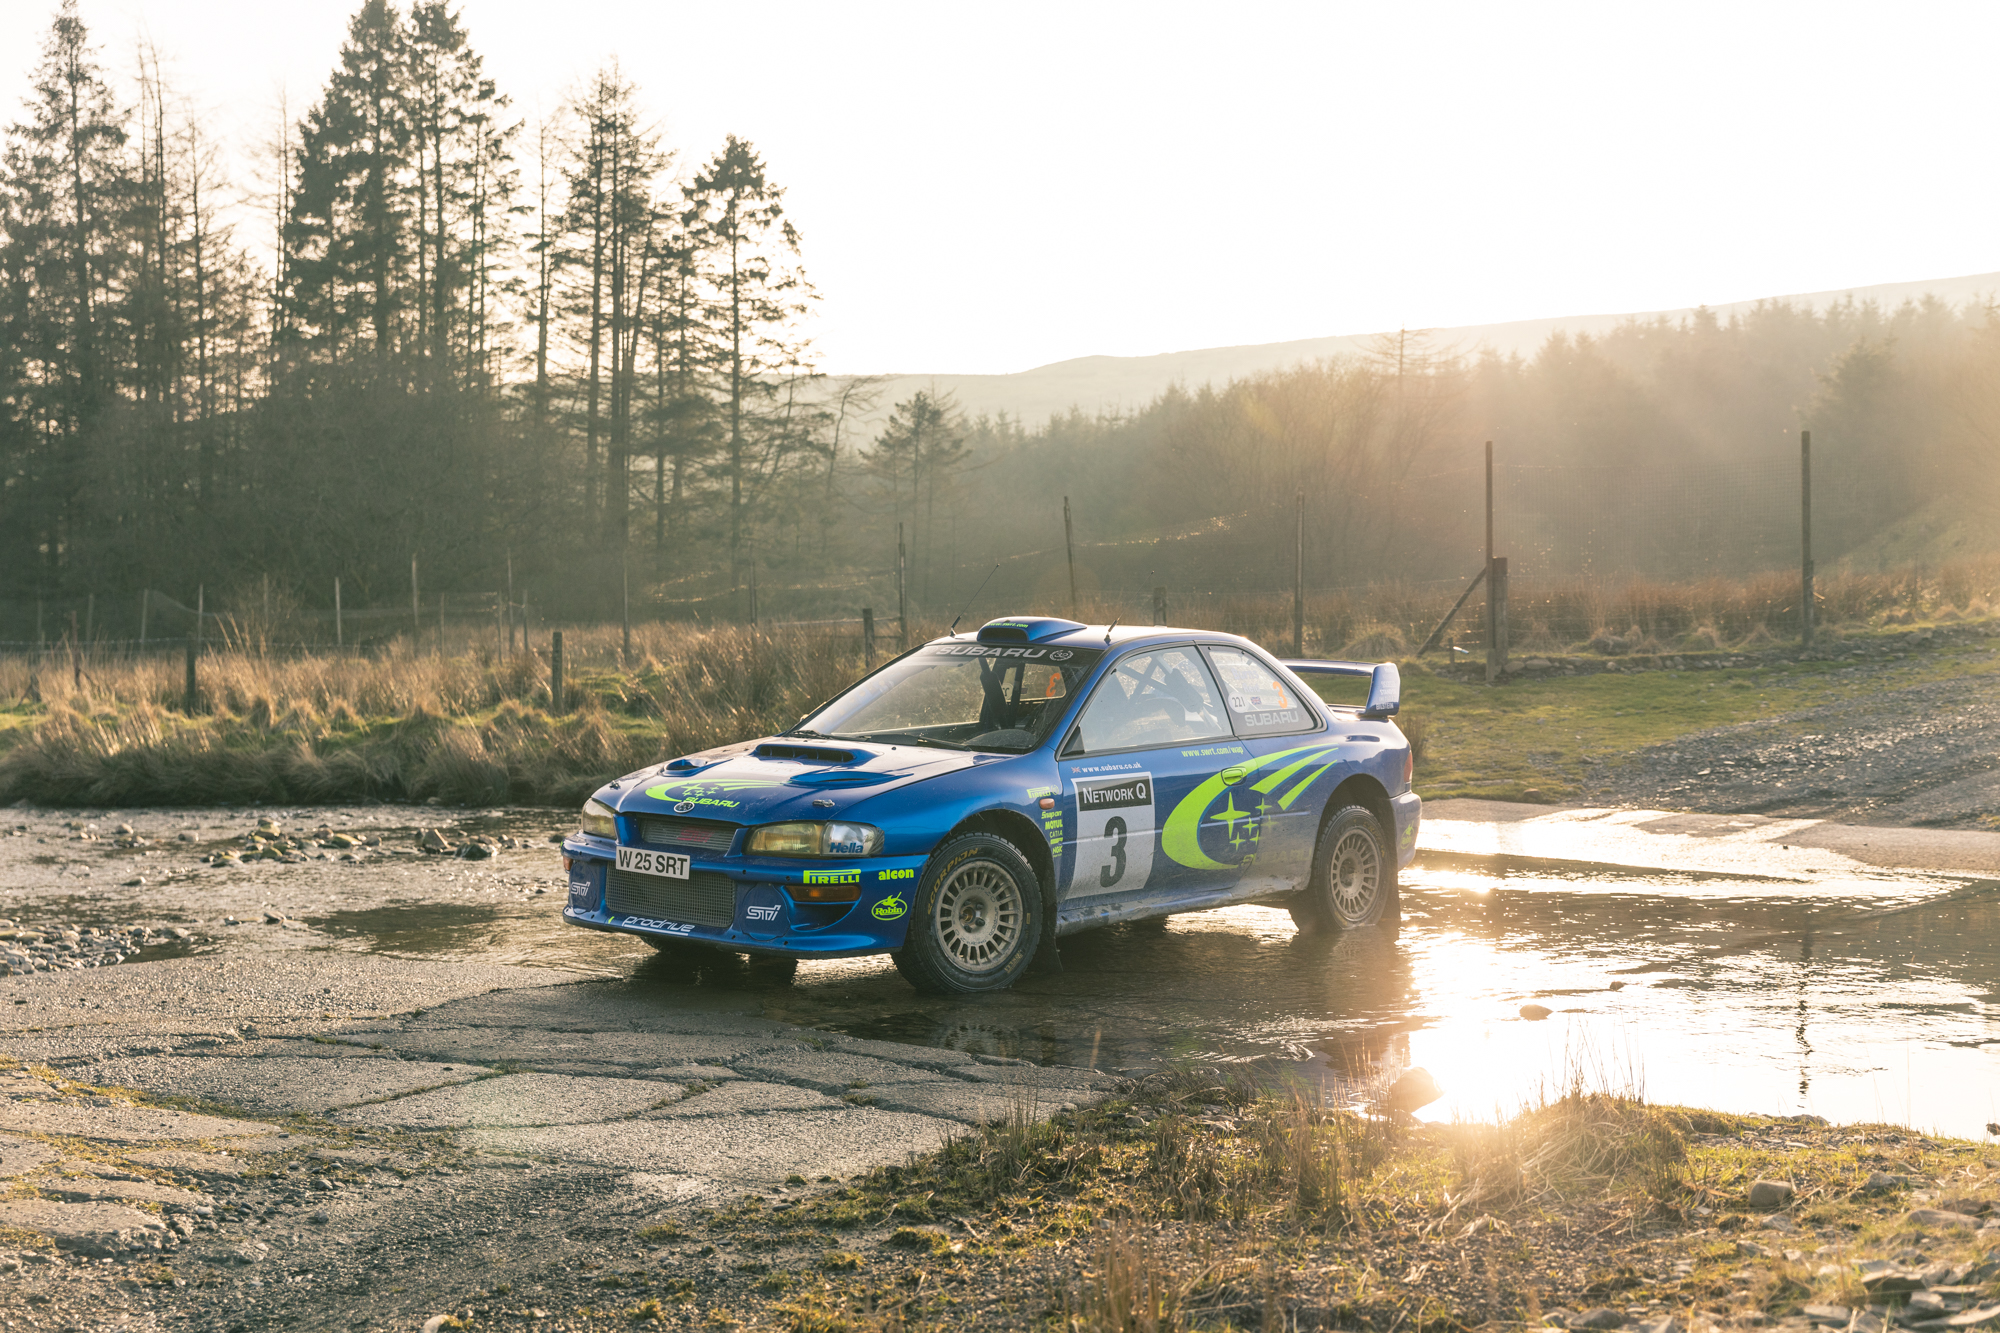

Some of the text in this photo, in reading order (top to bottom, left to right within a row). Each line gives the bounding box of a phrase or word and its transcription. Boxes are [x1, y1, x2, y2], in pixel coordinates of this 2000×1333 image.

[936, 646, 1048, 659] SUBARU
[1272, 681, 1288, 709] 3
[1375, 702, 1394, 711] BILSTEIN
[1244, 711, 1299, 727] SUBARU
[1081, 762, 1142, 773] www.subaru.co.uk
[1136, 782, 1147, 799] Q
[685, 796, 741, 808] SUBARU
[1045, 819, 1063, 830] MOTUL
[829, 842, 864, 854] Hella
[1101, 816, 1127, 888] 3
[618, 849, 688, 876] W 25 SRT
[803, 868, 862, 884] PIRELLI
[878, 869, 915, 881] alcon
[927, 847, 979, 915] SCORPION
[874, 905, 903, 916] Robin
[621, 916, 696, 933] prodrive
